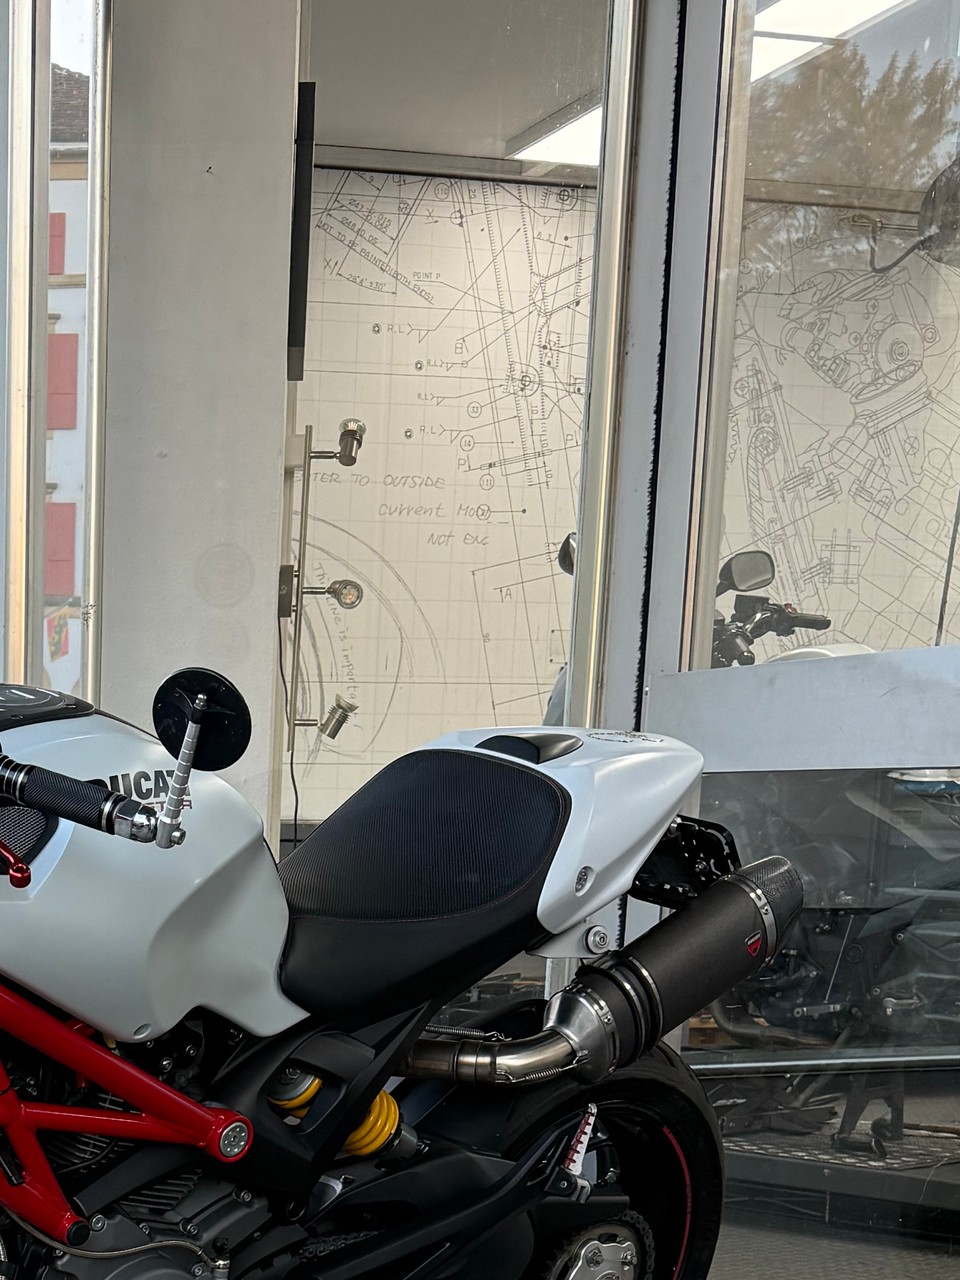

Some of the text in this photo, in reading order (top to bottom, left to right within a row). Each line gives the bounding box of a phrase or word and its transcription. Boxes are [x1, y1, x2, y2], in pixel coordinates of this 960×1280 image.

[323, 257, 332, 270] X
[337, 232, 347, 243] TO
[347, 240, 359, 249] BE
[413, 283, 434, 302] ENDS)
[413, 271, 432, 280] POINT
[454, 342, 464, 355] B
[350, 473, 371, 487] TO
[383, 474, 446, 488] OUTSIDE
[378, 502, 446, 518] Current
[505, 588, 515, 599] A
